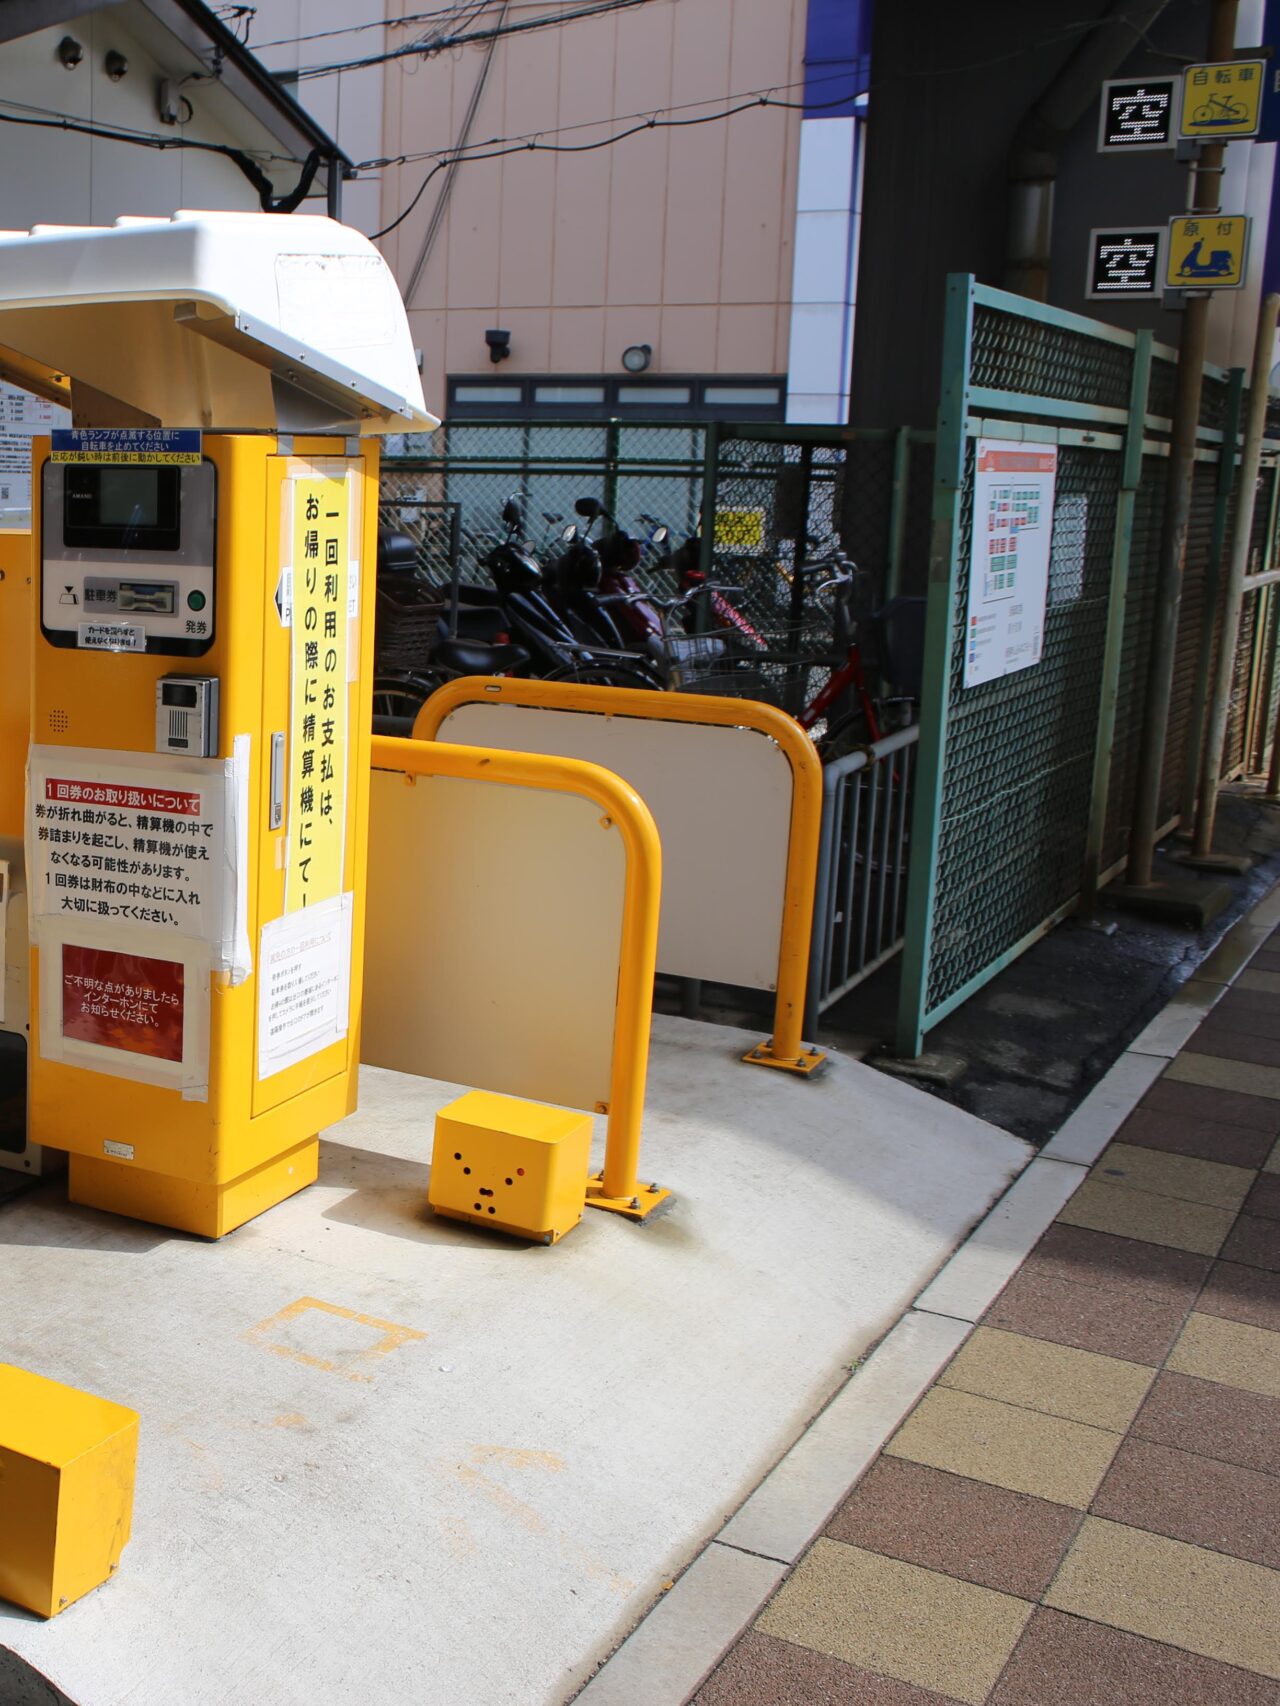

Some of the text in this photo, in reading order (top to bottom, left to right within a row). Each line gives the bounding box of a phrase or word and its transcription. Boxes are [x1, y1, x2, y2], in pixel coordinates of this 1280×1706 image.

[1193, 67, 1254, 86] 自転車
[1109, 89, 1169, 143] 空
[1182, 221, 1233, 237] 原付
[1097, 238, 1155, 290] 空
[71, 430, 180, 441] 青色ランプが点滅する位置に
[81, 441, 170, 451] 自転車を止めてください
[52, 452, 201, 464] 反応が鈍い時は前後に動かしてください
[84, 588, 118, 602] 駐車券
[185, 620, 208, 635] 発券
[320, 509, 340, 824] 一回利用のお支払は、
[47, 783, 200, 813] 1回券のお取り扱いについて
[35, 803, 214, 838] 券が折れ曲がると、精算機の中で
[38, 826, 210, 861] 券詰まりを起こし、精算機が使え
[50, 851, 191, 882] なくなる可能性があります。
[45, 872, 201, 905] 1回券は財布の中などに入れ
[61, 896, 180, 926] 大切に扱ってください。
[64, 974, 180, 1006] ご不明な点がありましたら
[83, 991, 159, 1014] インターホンにて
[80, 1001, 160, 1028] お知らせください。
